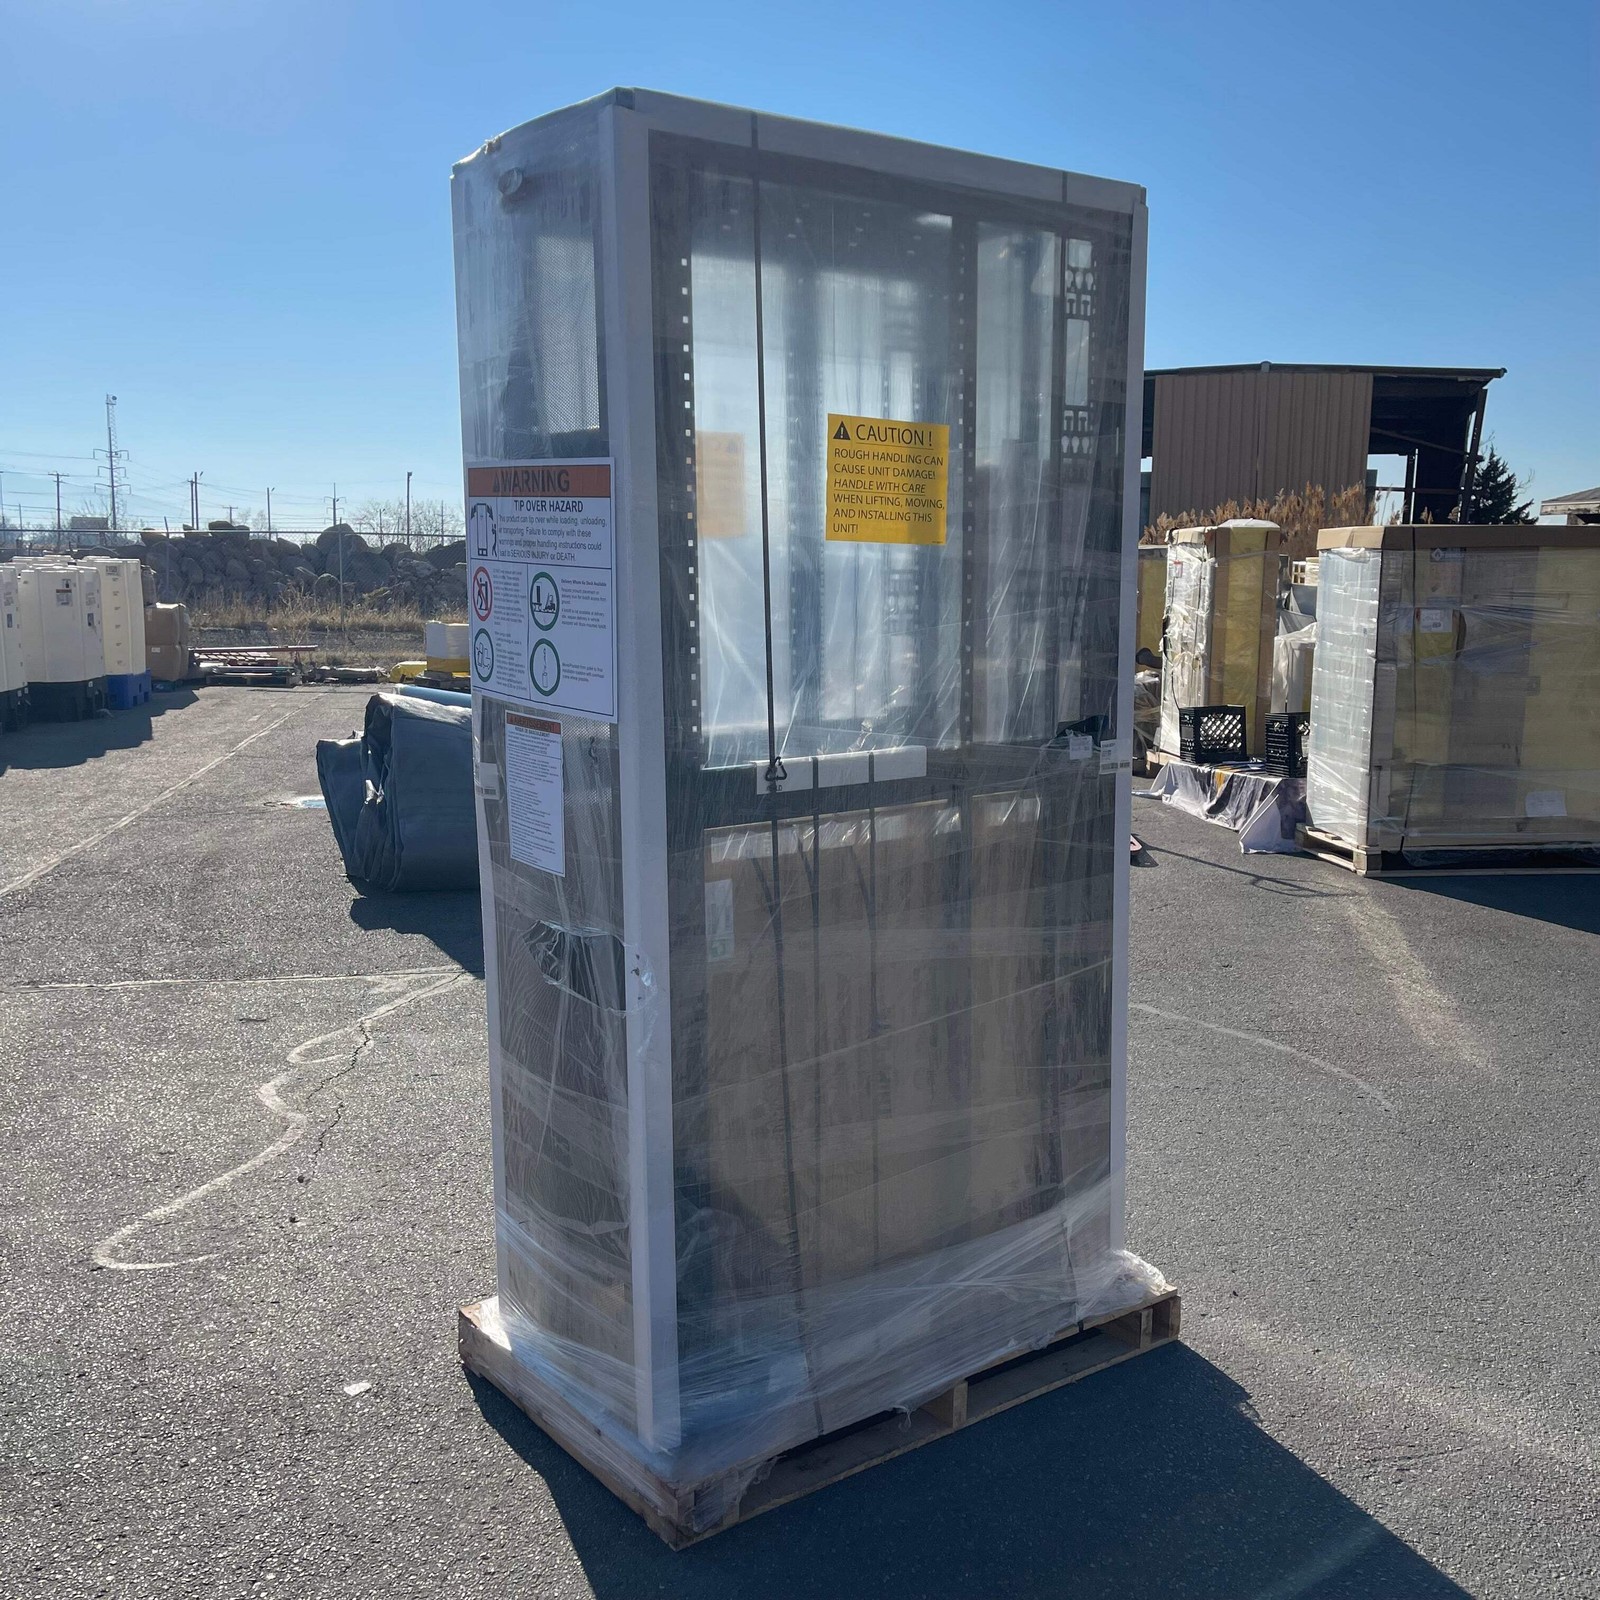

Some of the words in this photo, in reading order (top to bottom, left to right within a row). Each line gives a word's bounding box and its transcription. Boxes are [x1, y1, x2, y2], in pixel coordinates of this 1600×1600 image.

[856, 424, 924, 445] CAUTION
[834, 448, 870, 460] ROUGH
[872, 452, 922, 464] HANDLING
[924, 456, 943, 466] CAN
[834, 464, 865, 474] CAUSE
[868, 466, 890, 476] UNIT
[893, 468, 935, 479] DAMAGE!
[501, 470, 570, 492] WARNING
[834, 479, 873, 490] HANDLE
[876, 481, 899, 492] WITH
[902, 483, 926, 493] CARE
[514, 500, 525, 512] TIP
[526, 500, 546, 512] OVER
[549, 500, 583, 513] HAZARD
[834, 494, 863, 504] WHEN
[865, 496, 903, 508] LIFTING,
[905, 498, 944, 509] MOVING,
[834, 508, 855, 518] AND
[858, 510, 910, 521] INSTALLING
[913, 512, 932, 522] THIS
[526, 527, 540, 535] Failure
[548, 529, 564, 538] comply
[577, 529, 591, 537] these
[833, 524, 858, 533] UNIT!
[537, 539, 557, 550] handling
[558, 541, 587, 549] instructions
[588, 542, 602, 550] could
[511, 550, 530, 559] SERIOUS
[532, 551, 549, 560] INJURY
